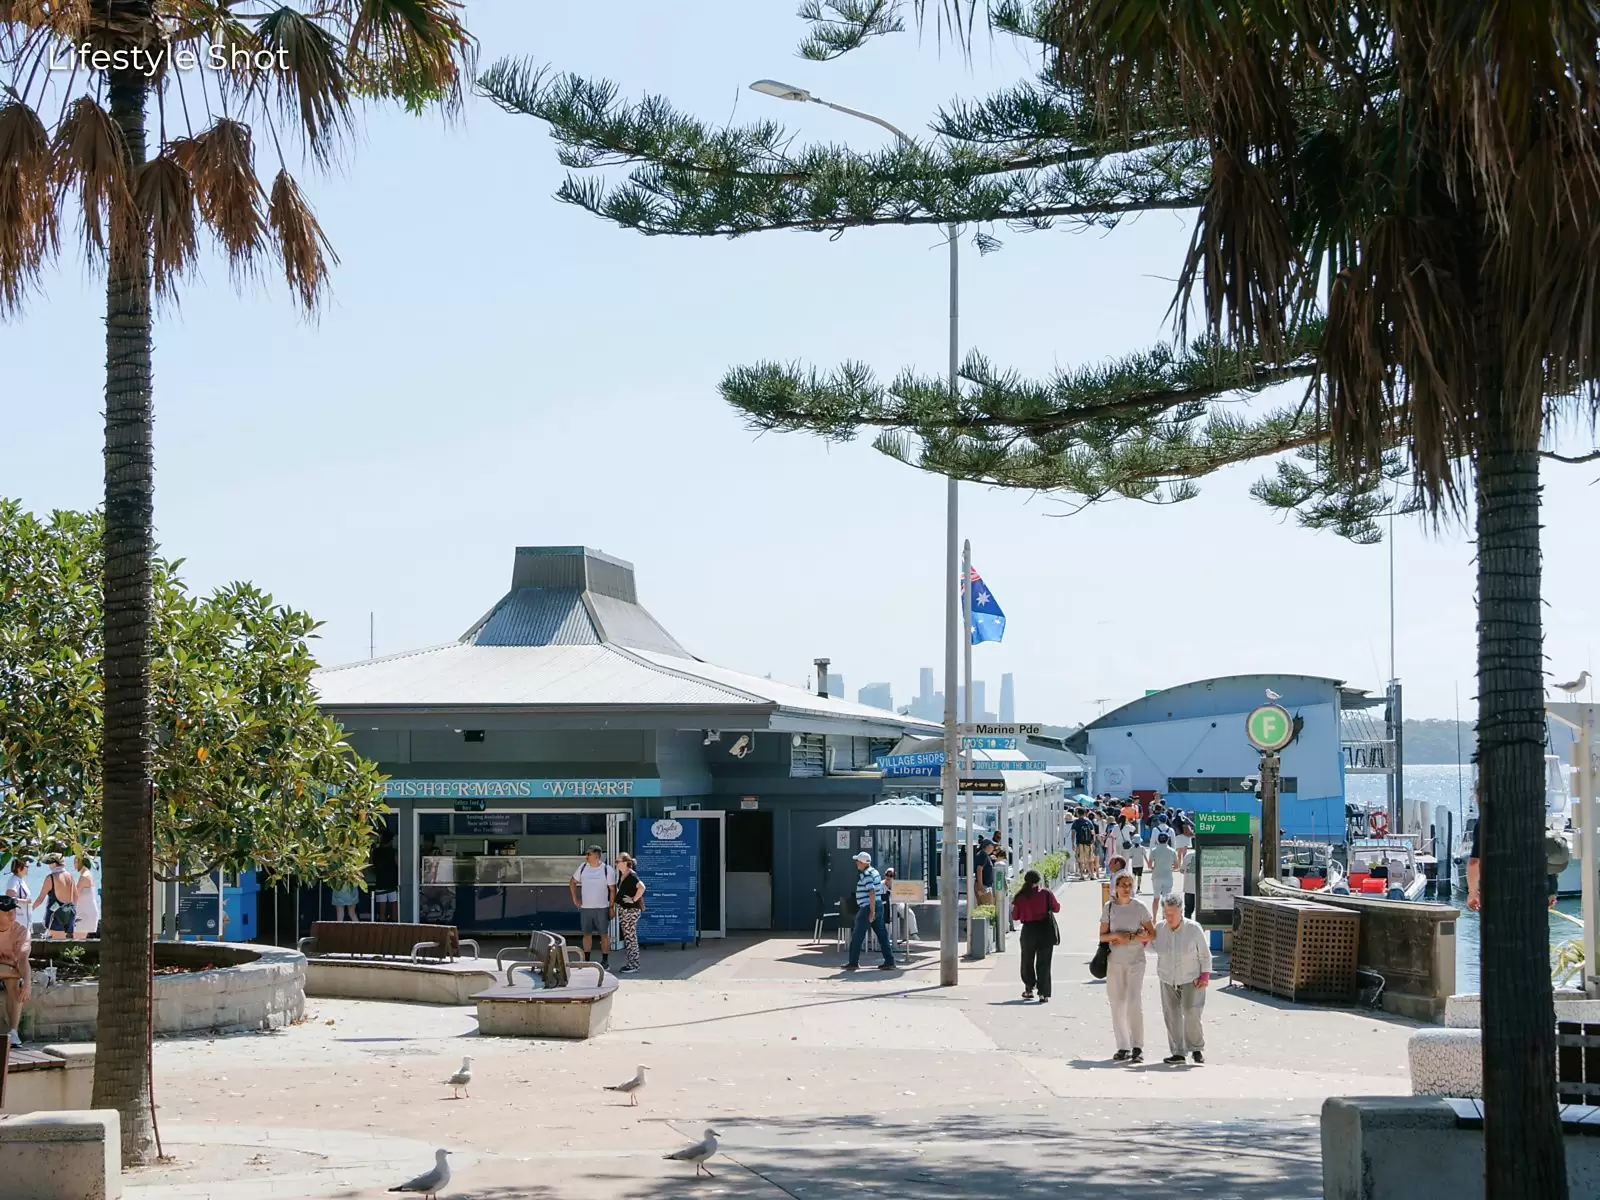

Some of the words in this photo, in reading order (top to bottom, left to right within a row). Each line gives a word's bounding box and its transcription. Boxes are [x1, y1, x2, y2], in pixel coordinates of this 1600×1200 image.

[976, 724, 1015, 734] Marine
[1019, 724, 1040, 734] Pde
[1262, 716, 1276, 738] F
[879, 755, 916, 768] VILLAGE
[917, 753, 945, 765] SHOPS
[893, 767, 933, 776] Library
[382, 781, 531, 796] FISHERMANS
[542, 781, 634, 796] WHARF
[1198, 813, 1236, 822] Watsons
[1199, 822, 1216, 832] Bay
